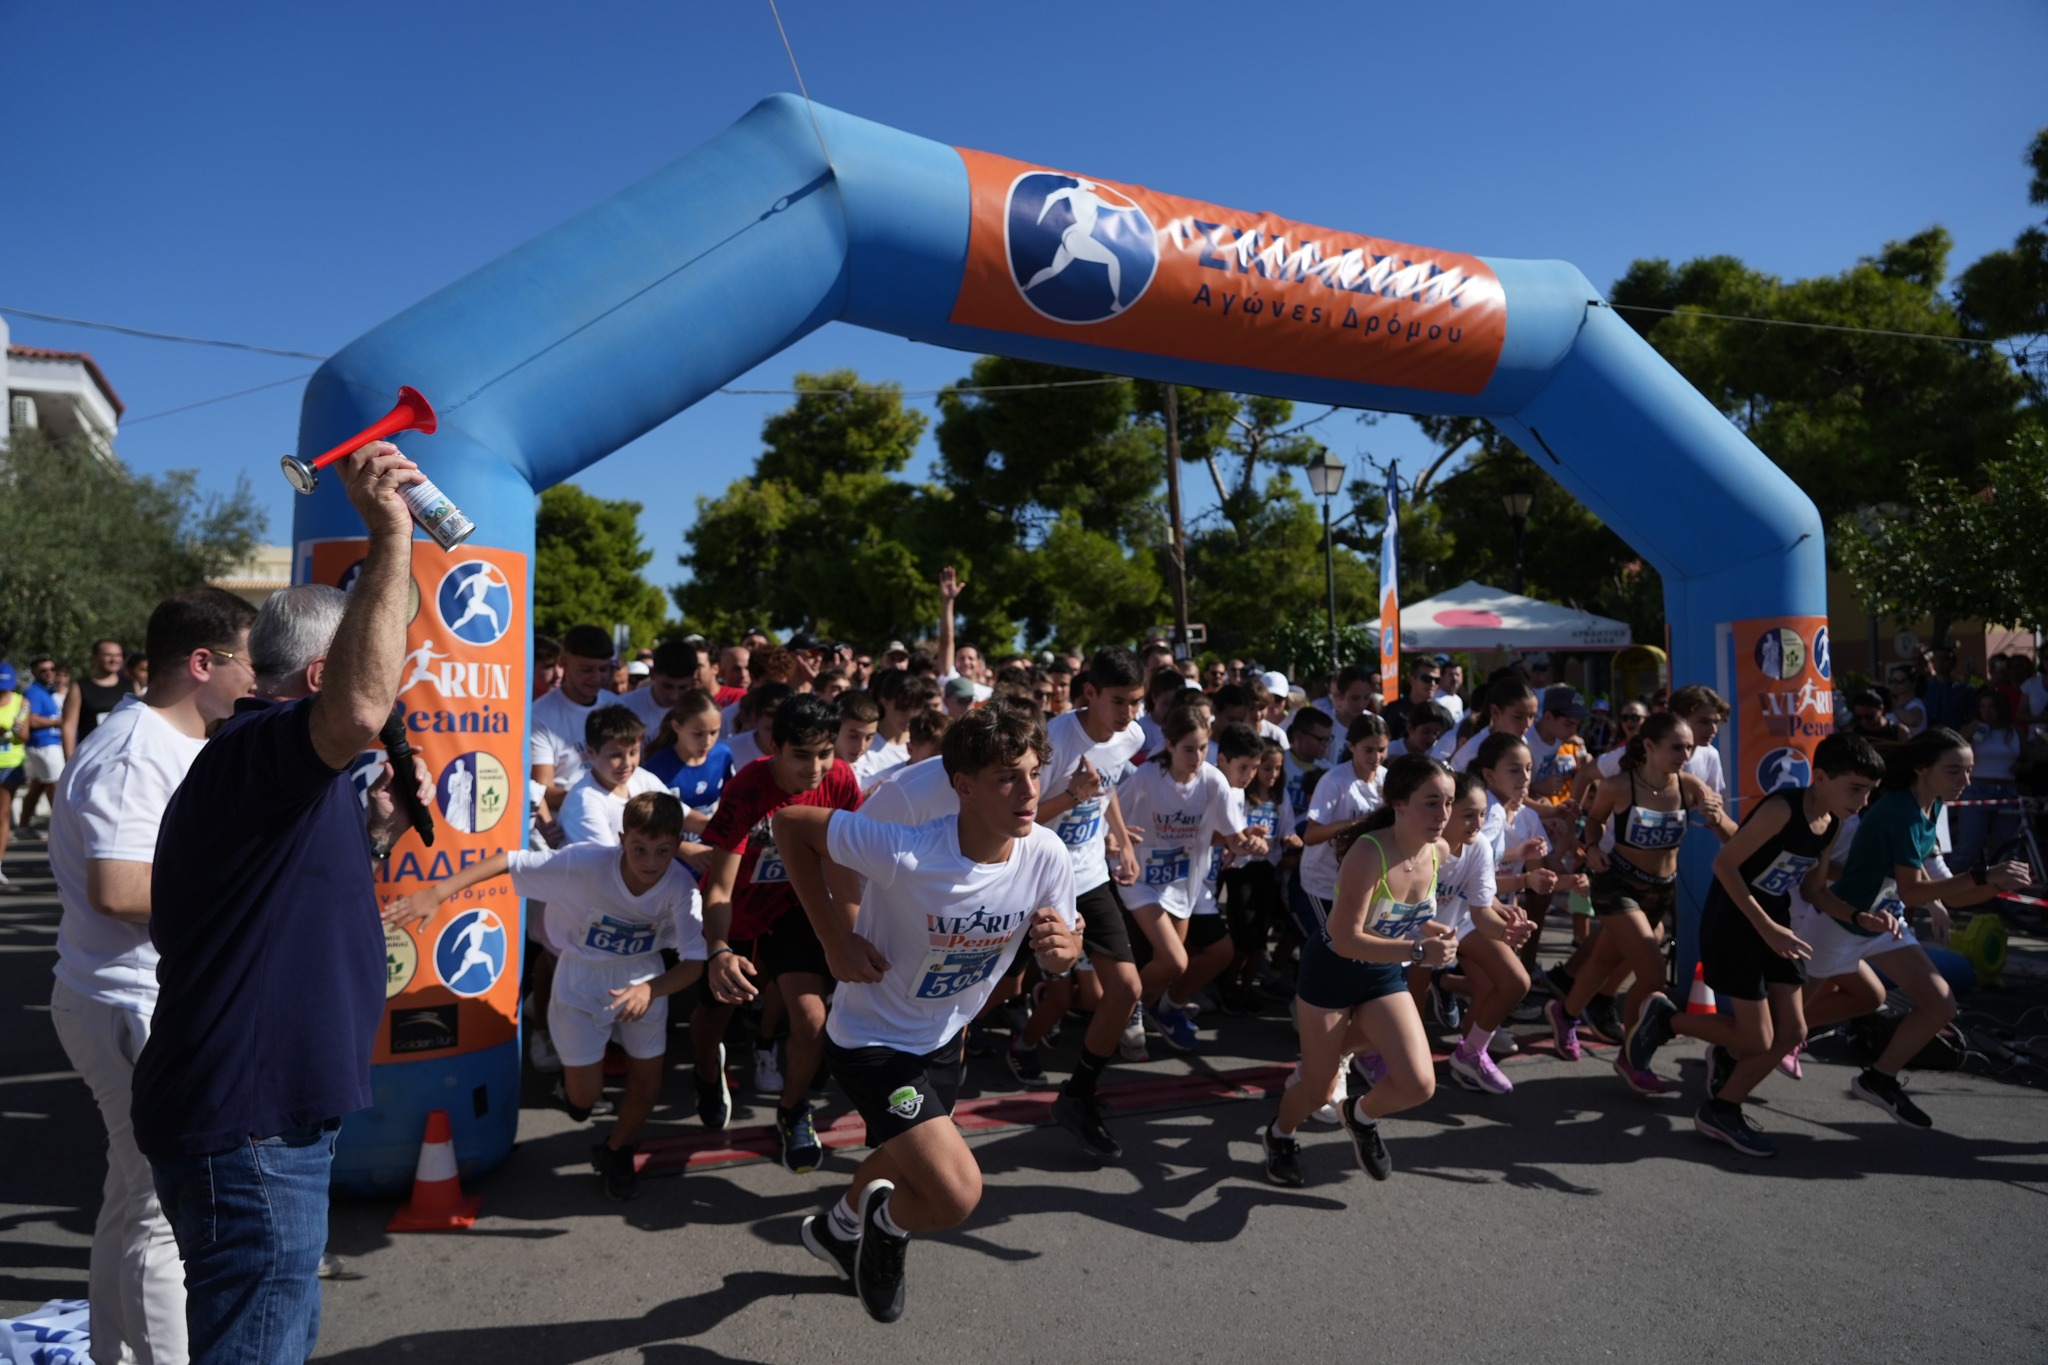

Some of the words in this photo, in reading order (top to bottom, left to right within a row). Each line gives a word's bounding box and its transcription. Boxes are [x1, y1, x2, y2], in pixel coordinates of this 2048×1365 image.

[1192, 283, 1322, 323] Αγώνες
[1341, 306, 1463, 343] Δρόμου
[441, 661, 512, 699] RUN
[1815, 690, 1834, 715] RU
[1788, 715, 1835, 737] Pean
[1061, 820, 1095, 844] 591
[1634, 827, 1675, 846] 585
[1149, 862, 1181, 884] 281
[449, 885, 508, 903] ρόμου
[926, 913, 970, 934] WE
[593, 931, 645, 954] 640
[946, 930, 1014, 949] Peani
